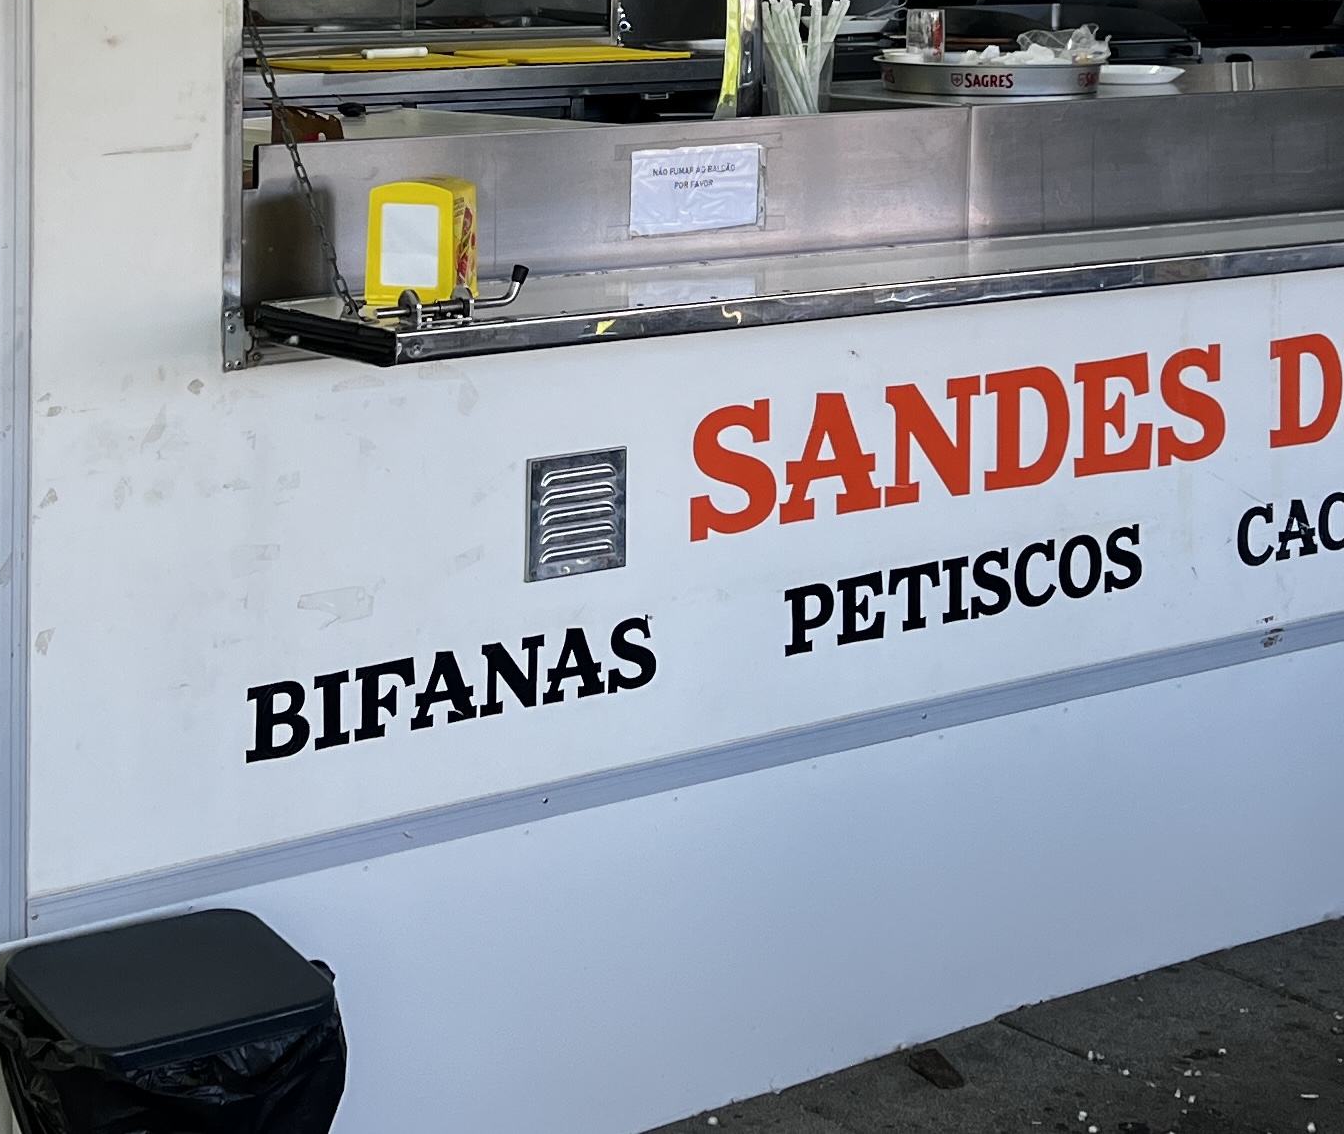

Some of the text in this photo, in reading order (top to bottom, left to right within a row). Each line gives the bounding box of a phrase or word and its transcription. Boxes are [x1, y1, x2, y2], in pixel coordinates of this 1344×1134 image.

[965, 72, 1014, 89] SAGRES
[652, 167, 668, 176] NÃO
[670, 166, 694, 176] FUMAR
[707, 162, 736, 173] BALCÃO
[674, 180, 714, 190] POR FAVOR
[690, 343, 1226, 542] SANDES
[245, 614, 658, 764] BIFANAS
[784, 523, 1143, 657] PETISCOS
